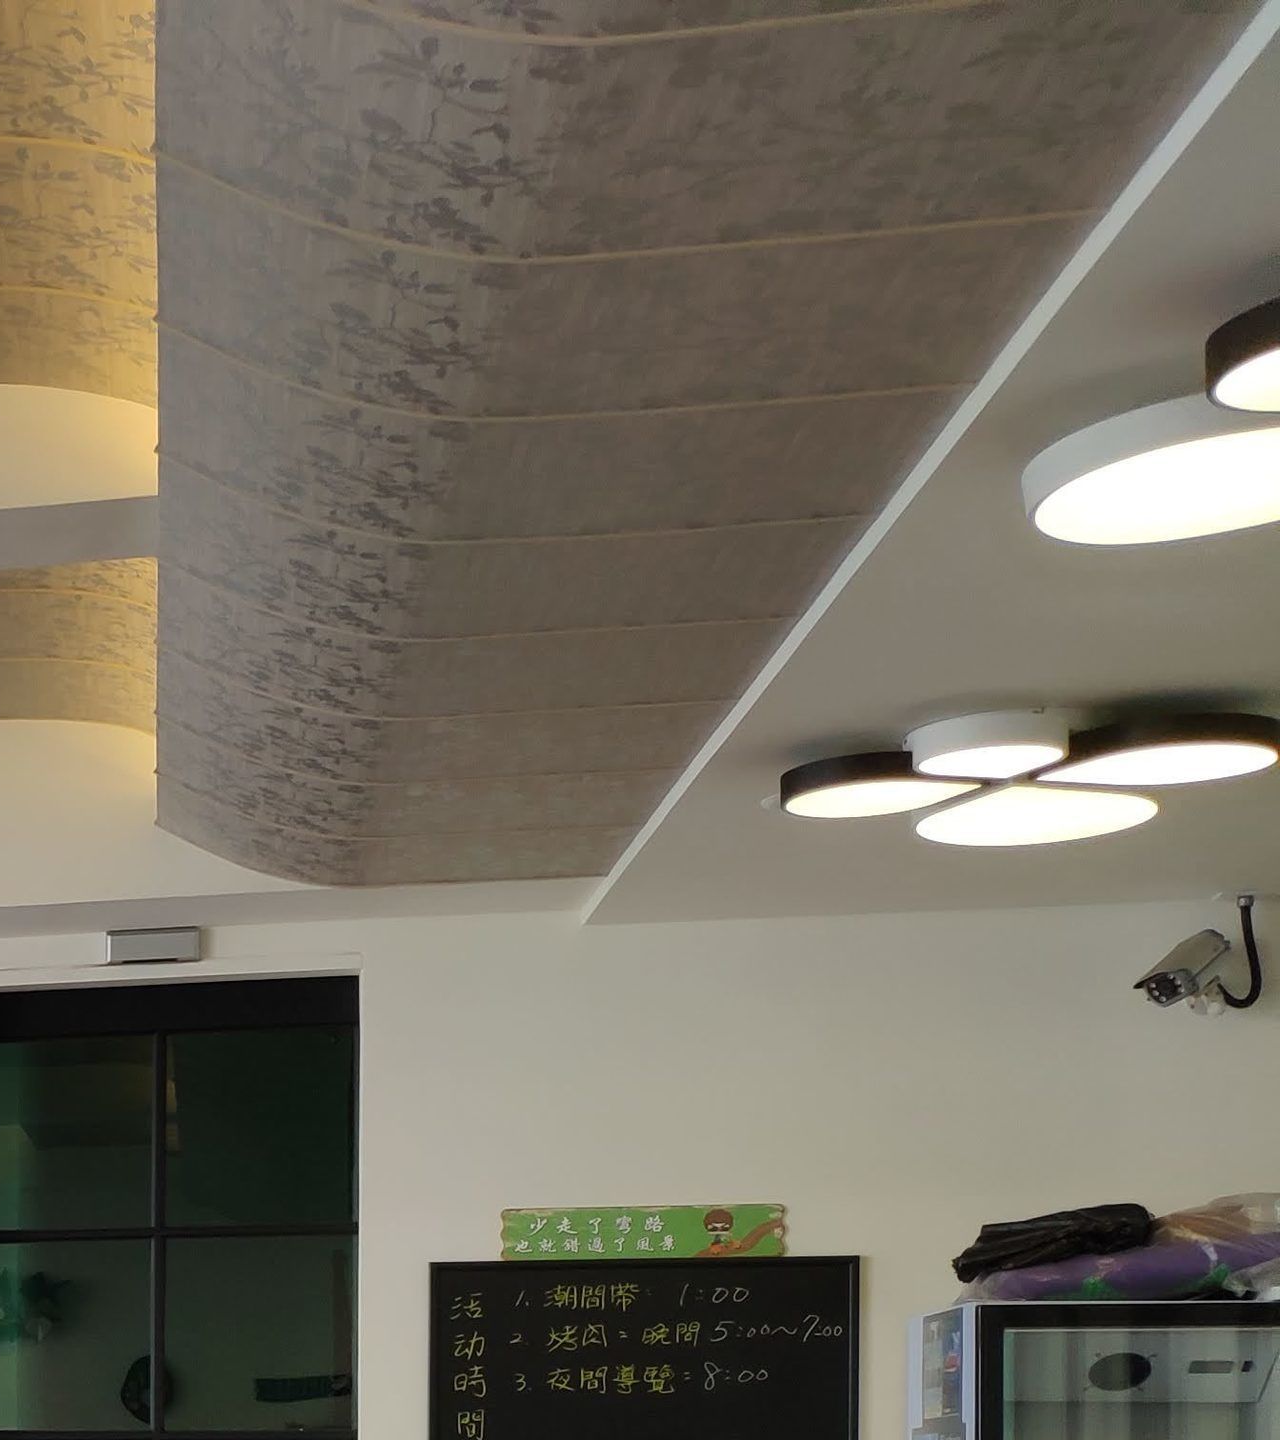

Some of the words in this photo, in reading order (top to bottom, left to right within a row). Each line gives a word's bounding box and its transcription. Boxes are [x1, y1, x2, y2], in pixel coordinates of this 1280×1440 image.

[530, 1214, 665, 1236] 少走了彎路
[514, 1234, 677, 1254] 也就錯過了風景
